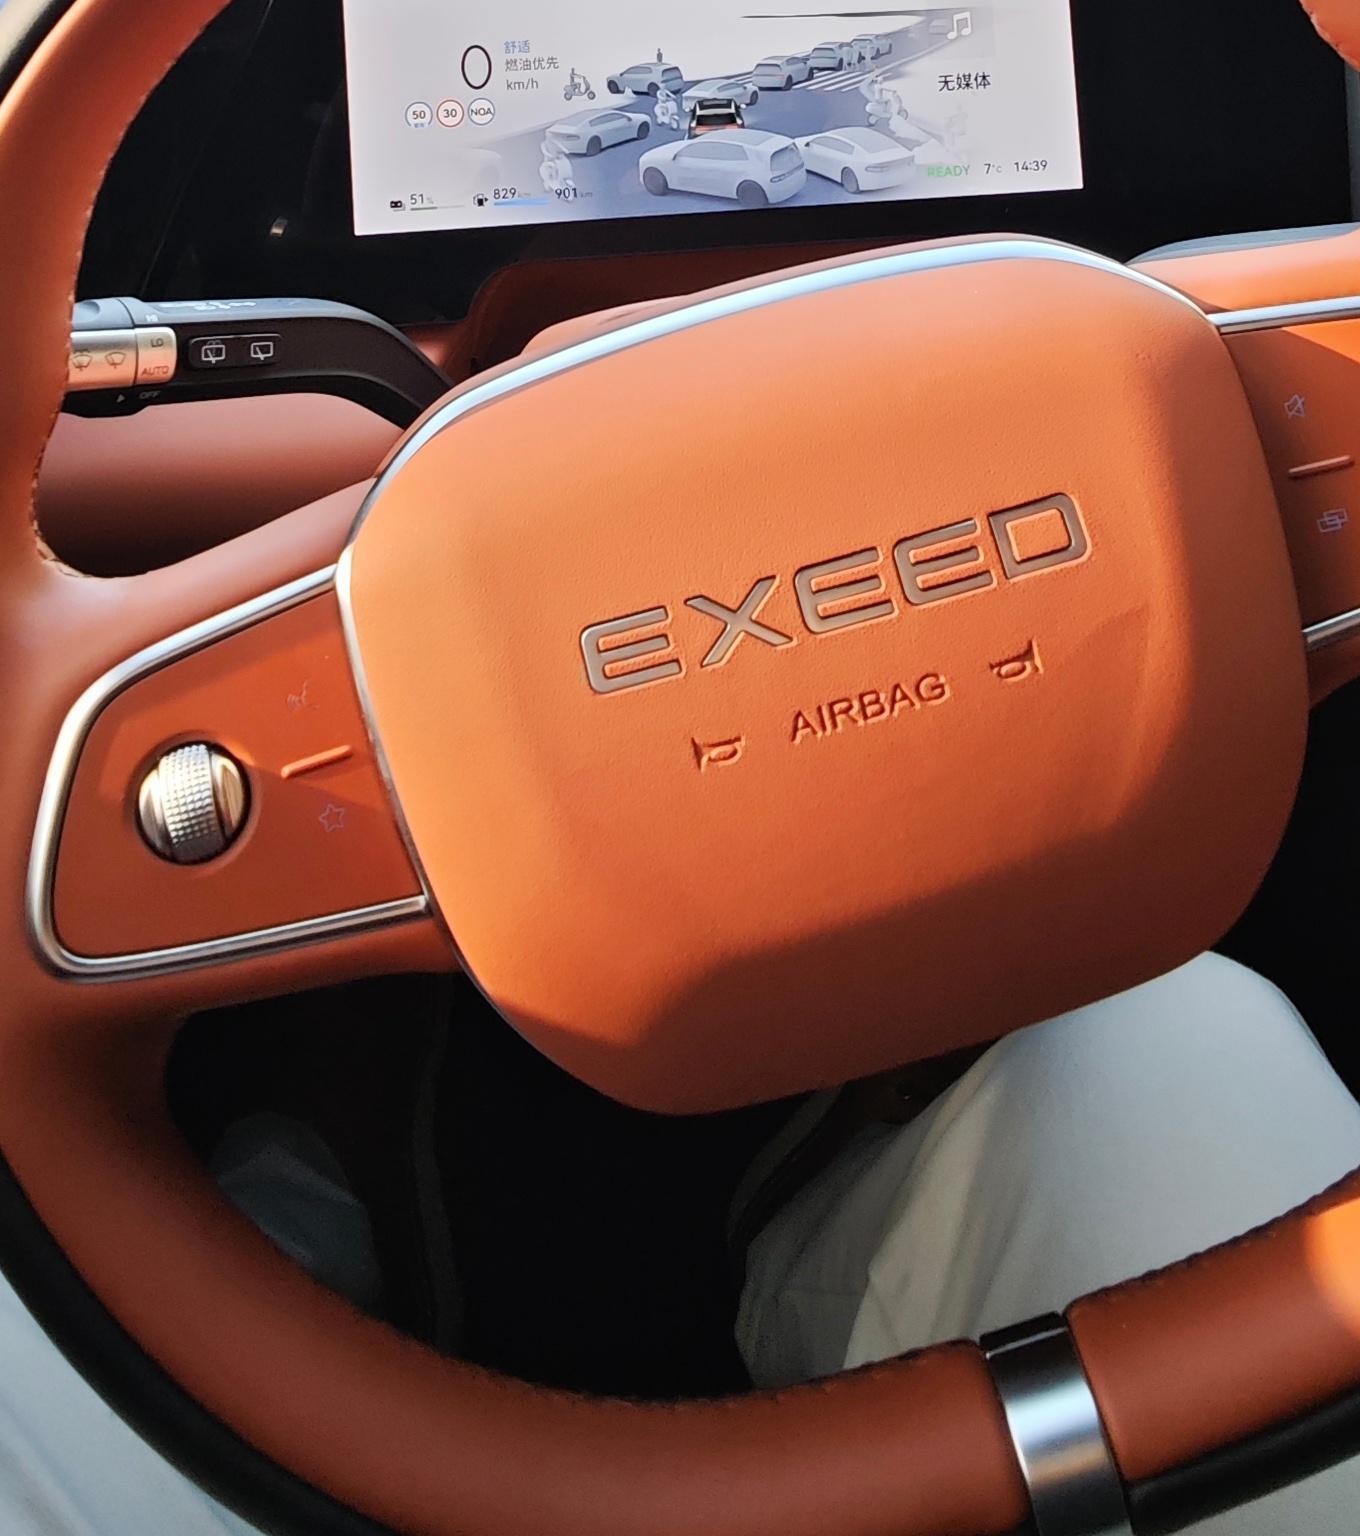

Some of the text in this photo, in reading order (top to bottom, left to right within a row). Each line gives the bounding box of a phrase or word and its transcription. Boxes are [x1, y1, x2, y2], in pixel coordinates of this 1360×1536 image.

[503, 39, 531, 54] 舒适
[461, 44, 492, 90] 0
[504, 56, 560, 72] 燃油优先
[506, 77, 539, 91] km/h
[937, 71, 991, 92] 无媒体
[412, 110, 426, 120] 50
[443, 108, 458, 118] 30
[927, 165, 971, 177] READY
[1014, 159, 1048, 172] 14:39
[493, 187, 517, 199] 829
[554, 187, 578, 199] 901
[141, 365, 170, 377] AUTO
[140, 390, 161, 400] OFF
[579, 490, 1093, 696] EXEED
[791, 671, 951, 743] AIRBAG
